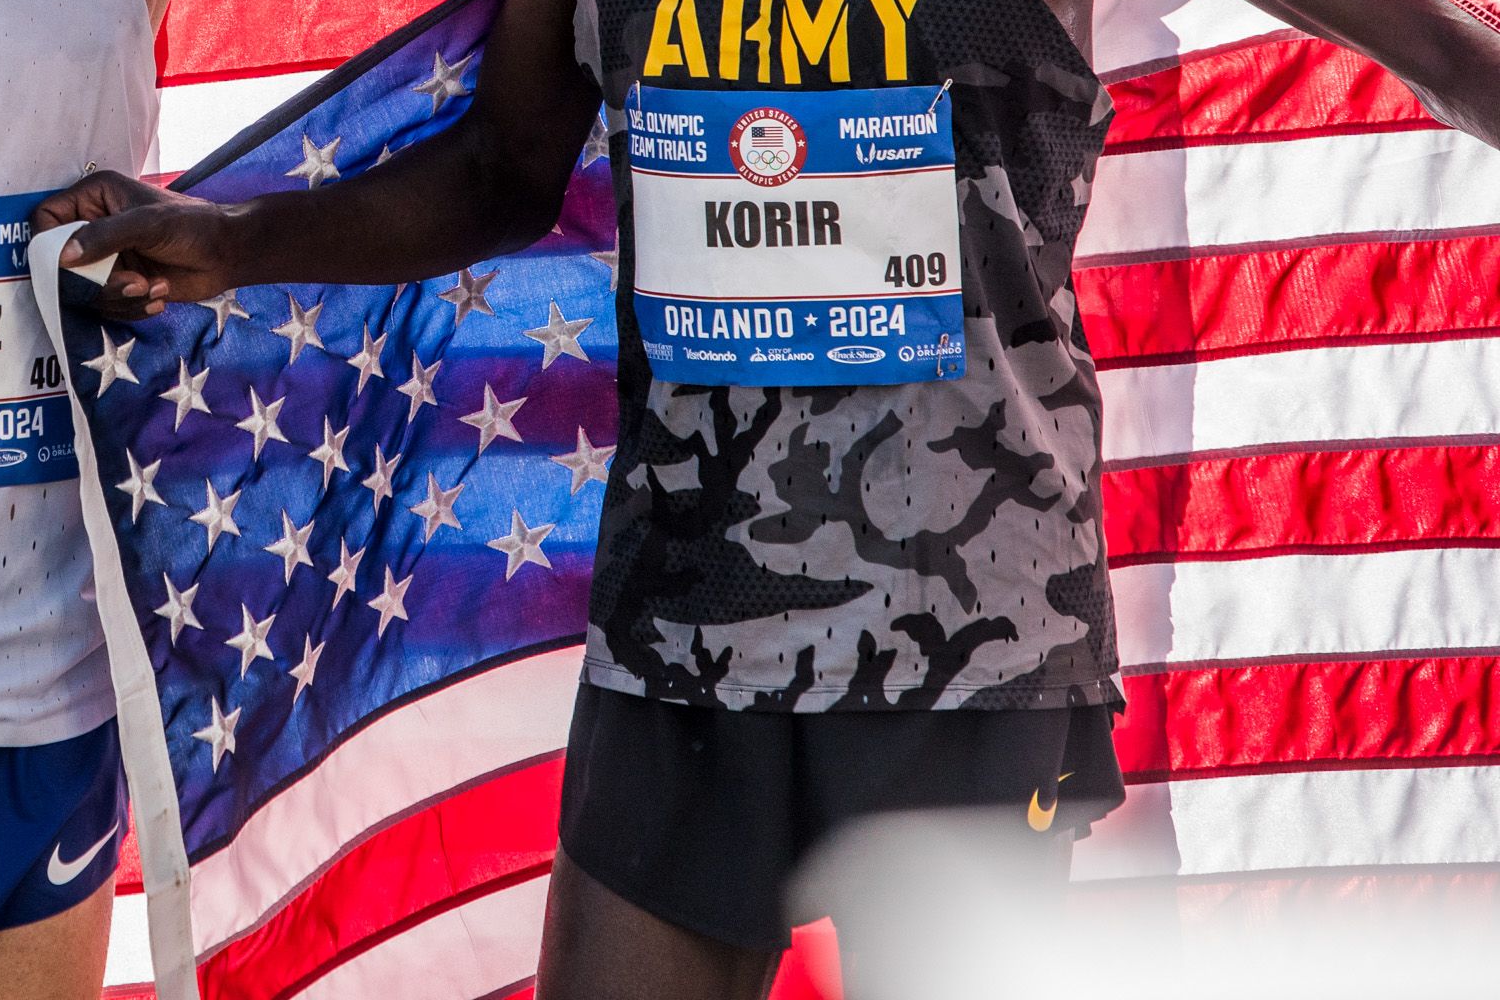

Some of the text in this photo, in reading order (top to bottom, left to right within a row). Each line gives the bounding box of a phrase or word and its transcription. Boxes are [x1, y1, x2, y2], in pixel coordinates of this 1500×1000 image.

[646, 111, 705, 137] OLYMPIC
[736, 110, 798, 131] UNITED STATES
[839, 113, 938, 139] MARATHON
[631, 133, 707, 162] TEAM TRIALS
[876, 147, 924, 161] USATF
[739, 165, 799, 185] OLYMPIC TEAM
[704, 200, 842, 249] KORIR
[884, 252, 947, 288] 409
[664, 304, 906, 340] ORLANDO 2024
[768, 352, 815, 362] ORLANDO
[30, 354, 65, 390] 40
